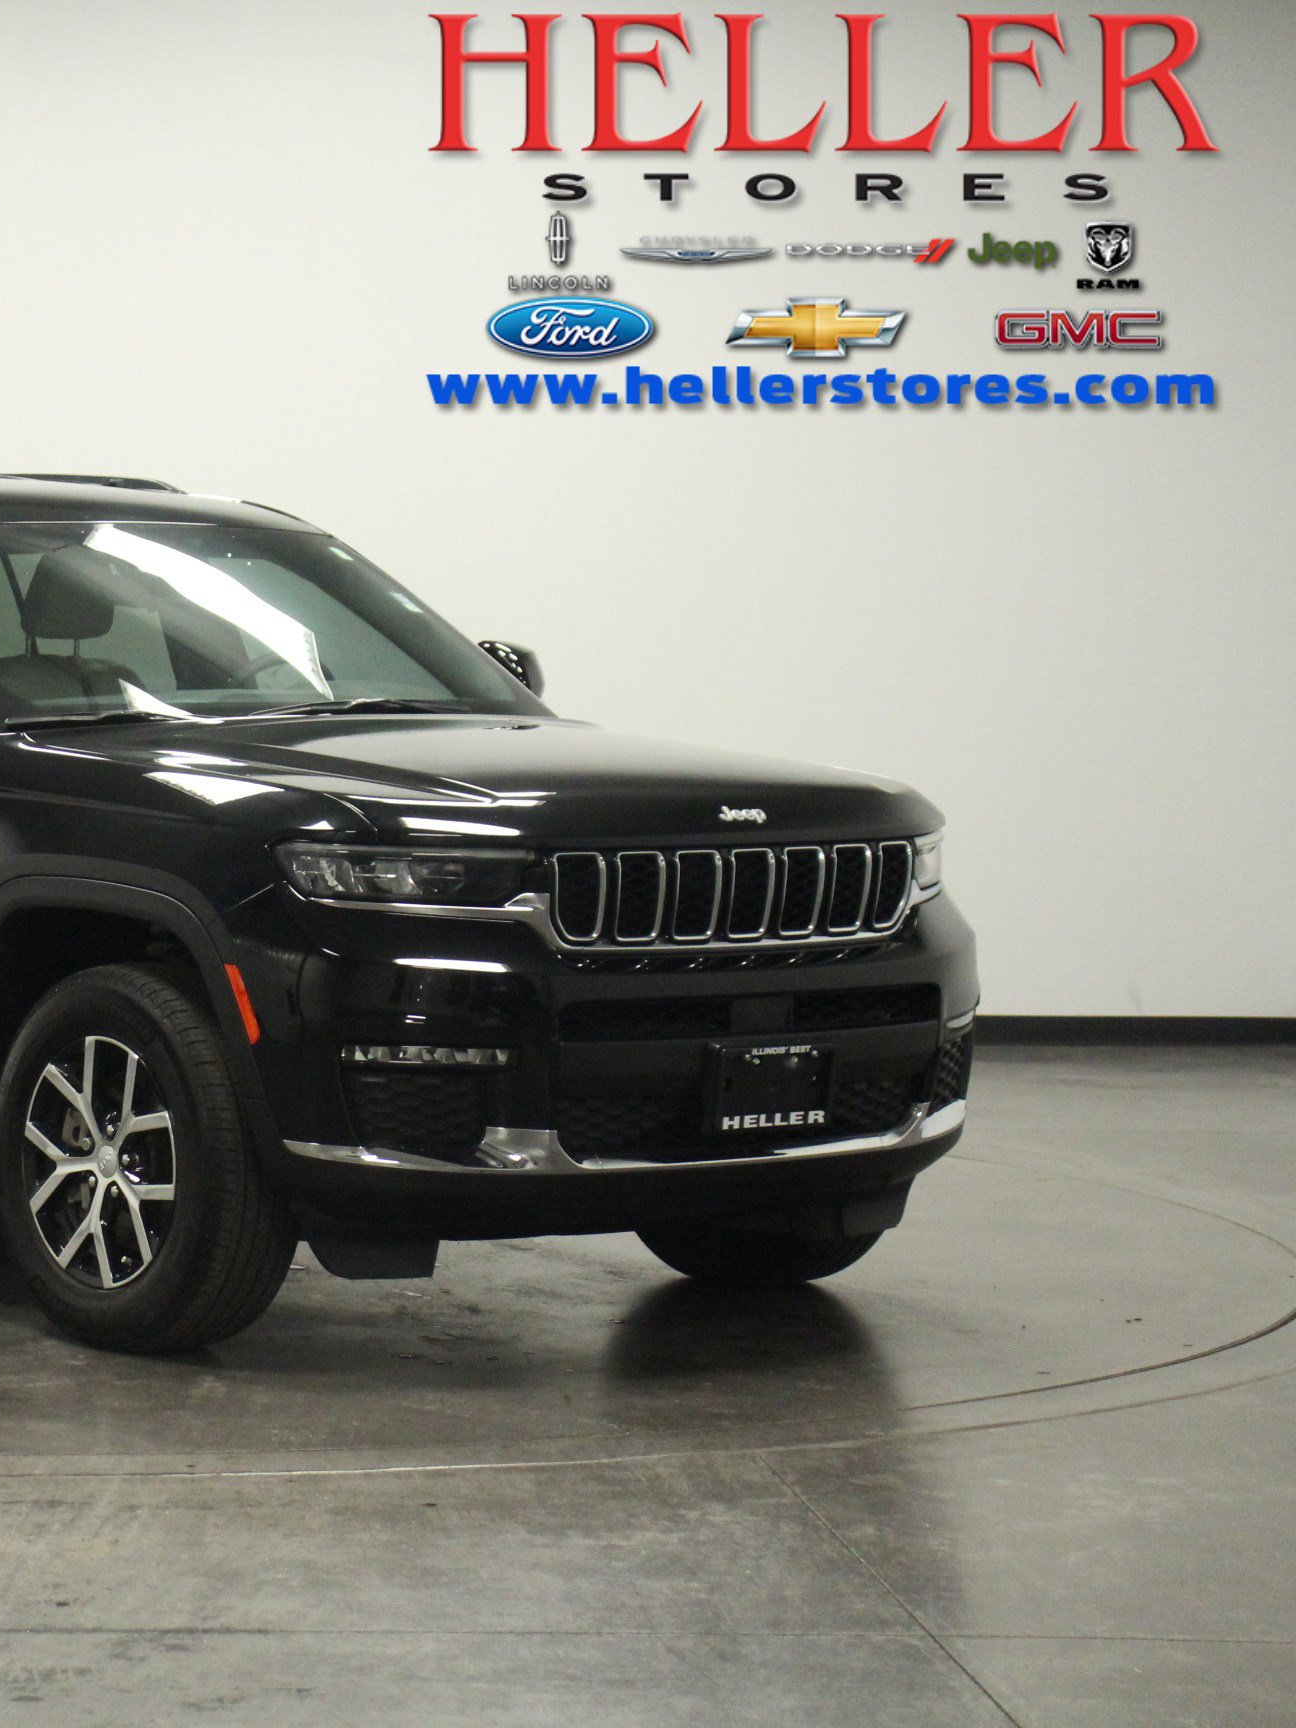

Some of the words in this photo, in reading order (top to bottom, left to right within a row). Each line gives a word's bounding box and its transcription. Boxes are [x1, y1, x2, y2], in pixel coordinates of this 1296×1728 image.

[719, 805, 768, 824] Jeep
[789, 1045, 812, 1054] BEST
[722, 1110, 826, 1130] HELLER
